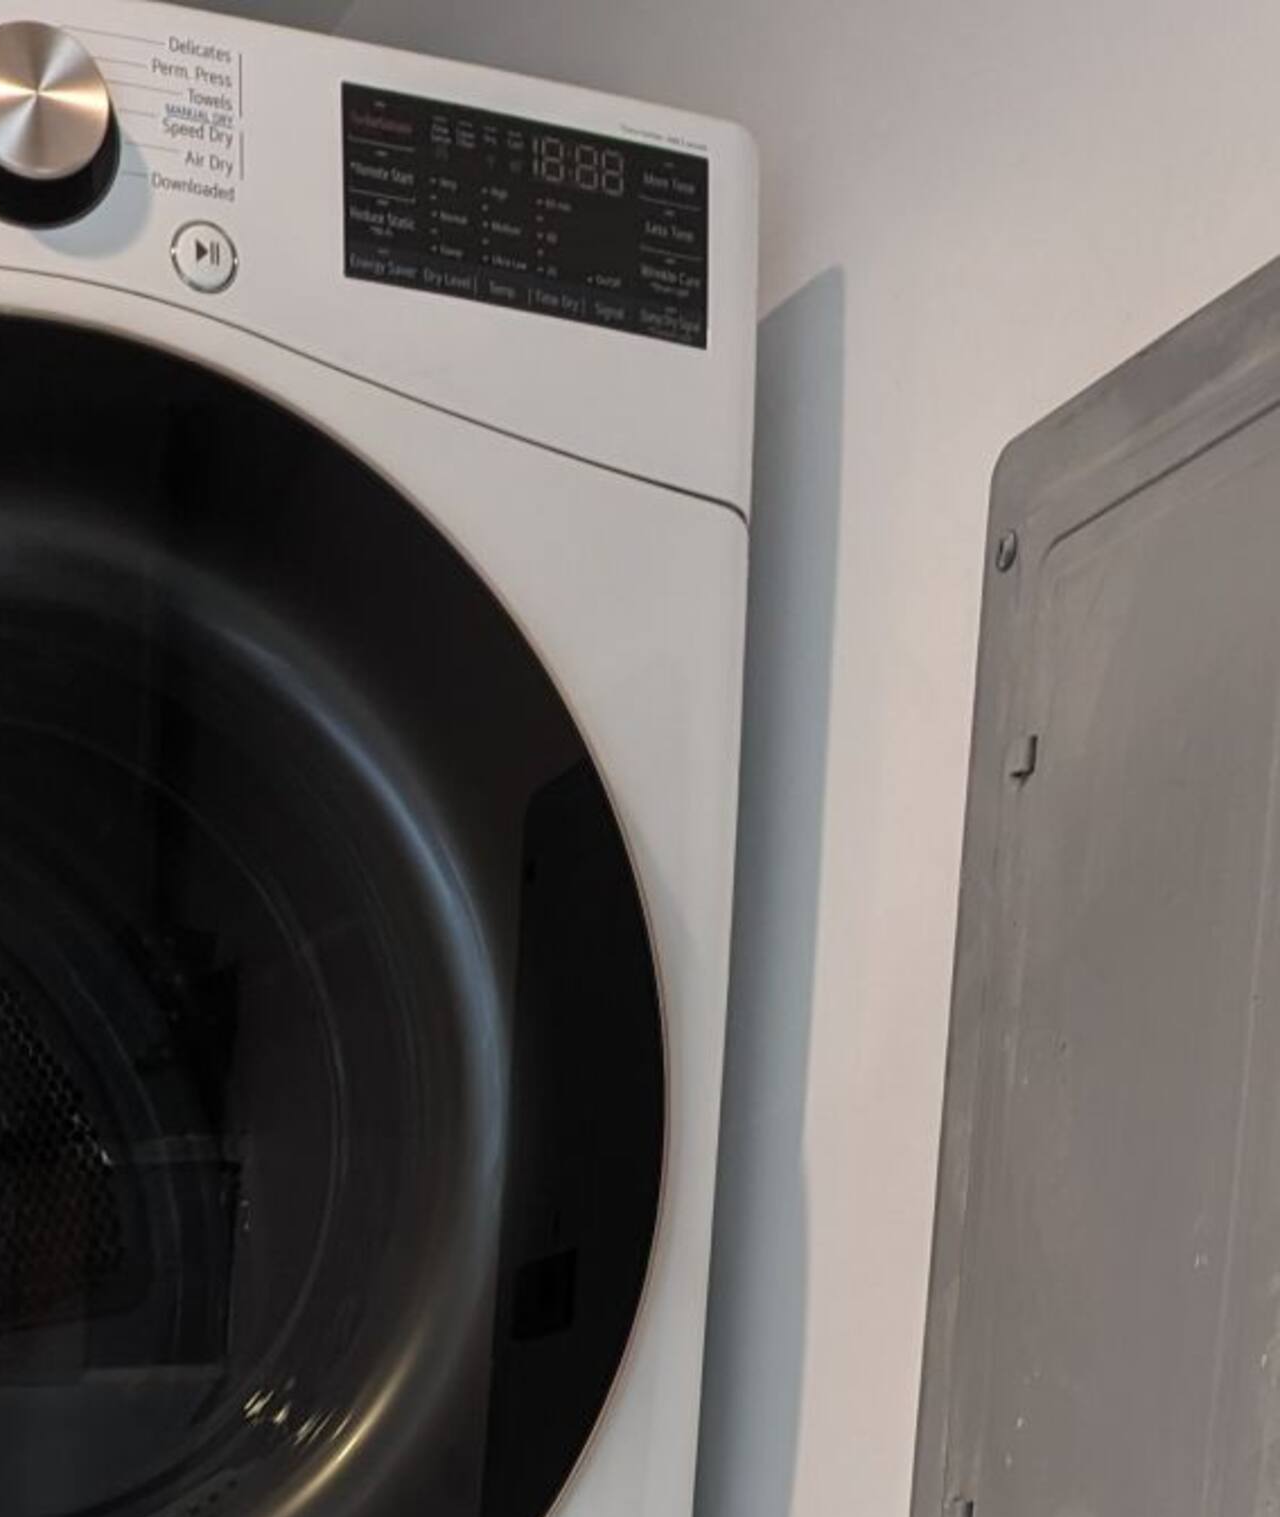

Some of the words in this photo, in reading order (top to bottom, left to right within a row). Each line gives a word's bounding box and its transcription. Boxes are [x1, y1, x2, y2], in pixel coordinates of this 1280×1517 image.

[168, 36, 233, 63] Delicates
[152, 57, 190, 80] Perm.
[195, 67, 233, 88] Press
[165, 103, 209, 124] MANUAL
[187, 88, 233, 112] Towels
[162, 118, 205, 141] Speed
[209, 126, 234, 151] Dry
[184, 150, 206, 169] Air
[209, 154, 234, 178] Dry
[151, 172, 236, 203] Downloaded
